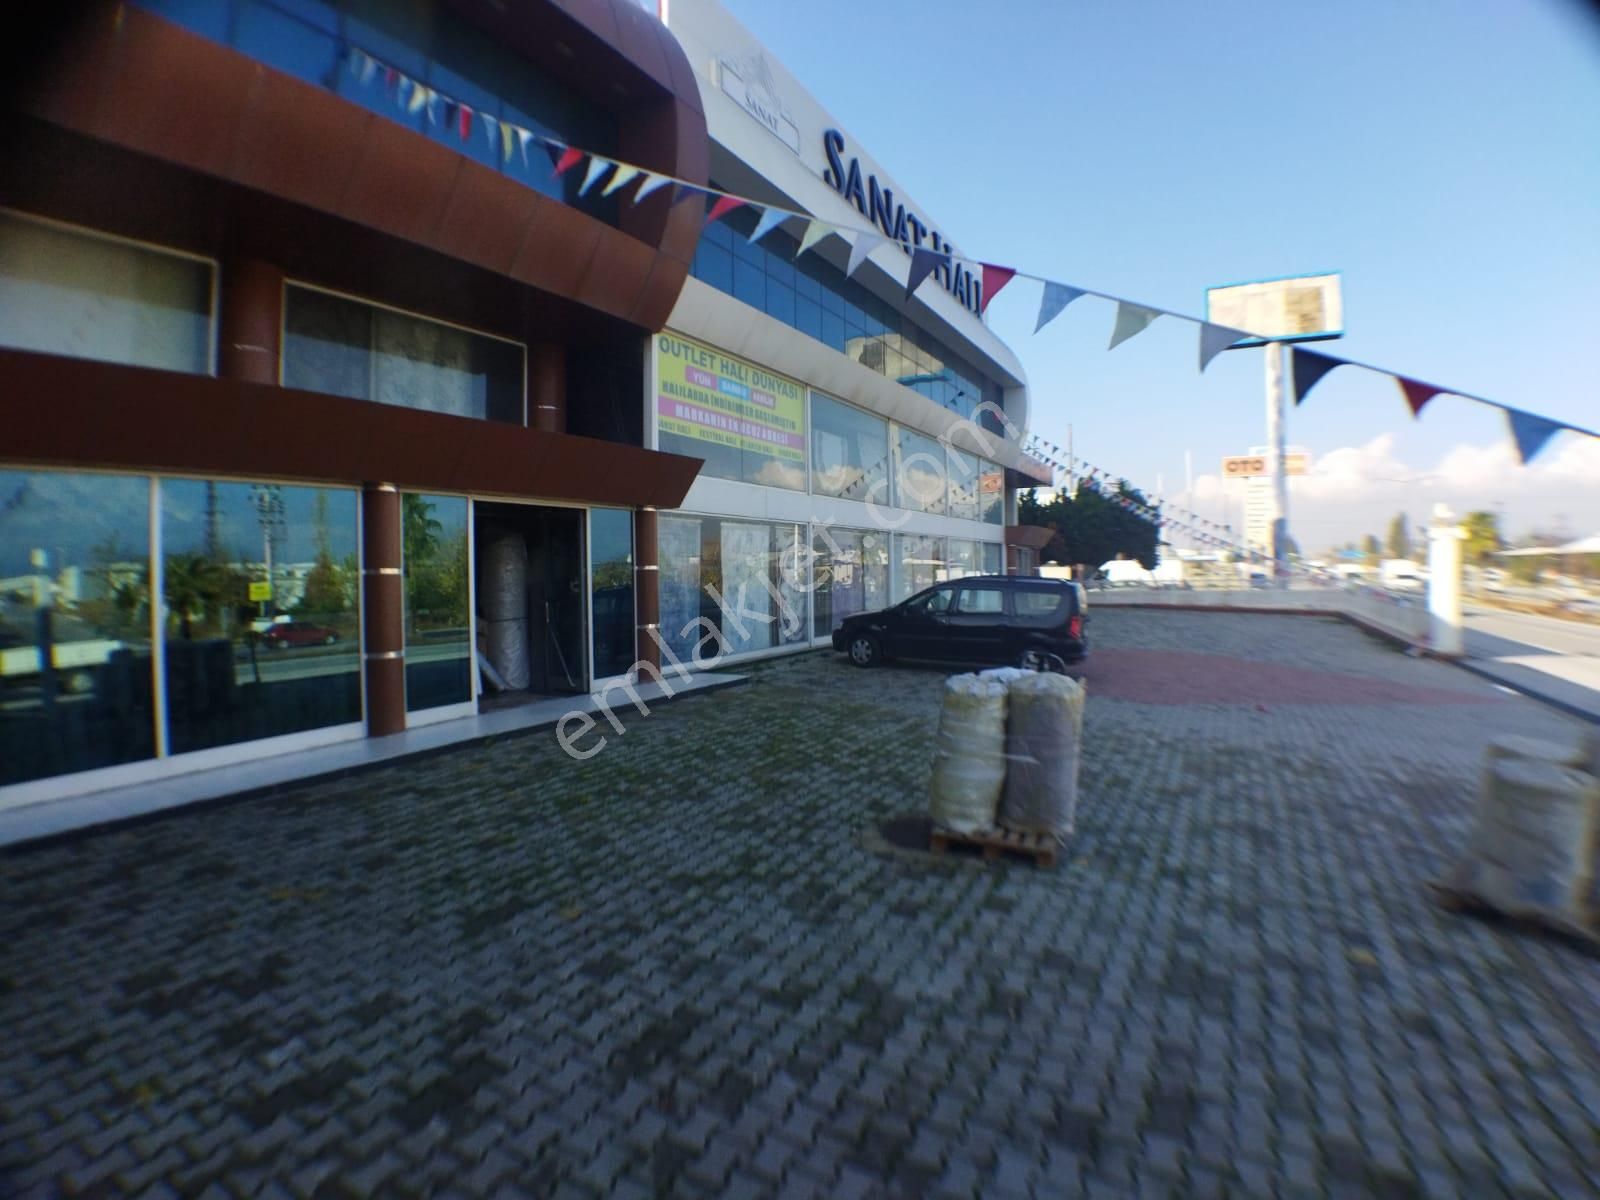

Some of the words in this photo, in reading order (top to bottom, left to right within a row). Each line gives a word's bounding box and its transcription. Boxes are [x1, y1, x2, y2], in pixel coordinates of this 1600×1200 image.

[823, 128, 928, 254] SANAT
[659, 335, 716, 369] OUTLET
[720, 359, 749, 383] HALI
[1226, 459, 1265, 473] OTO
